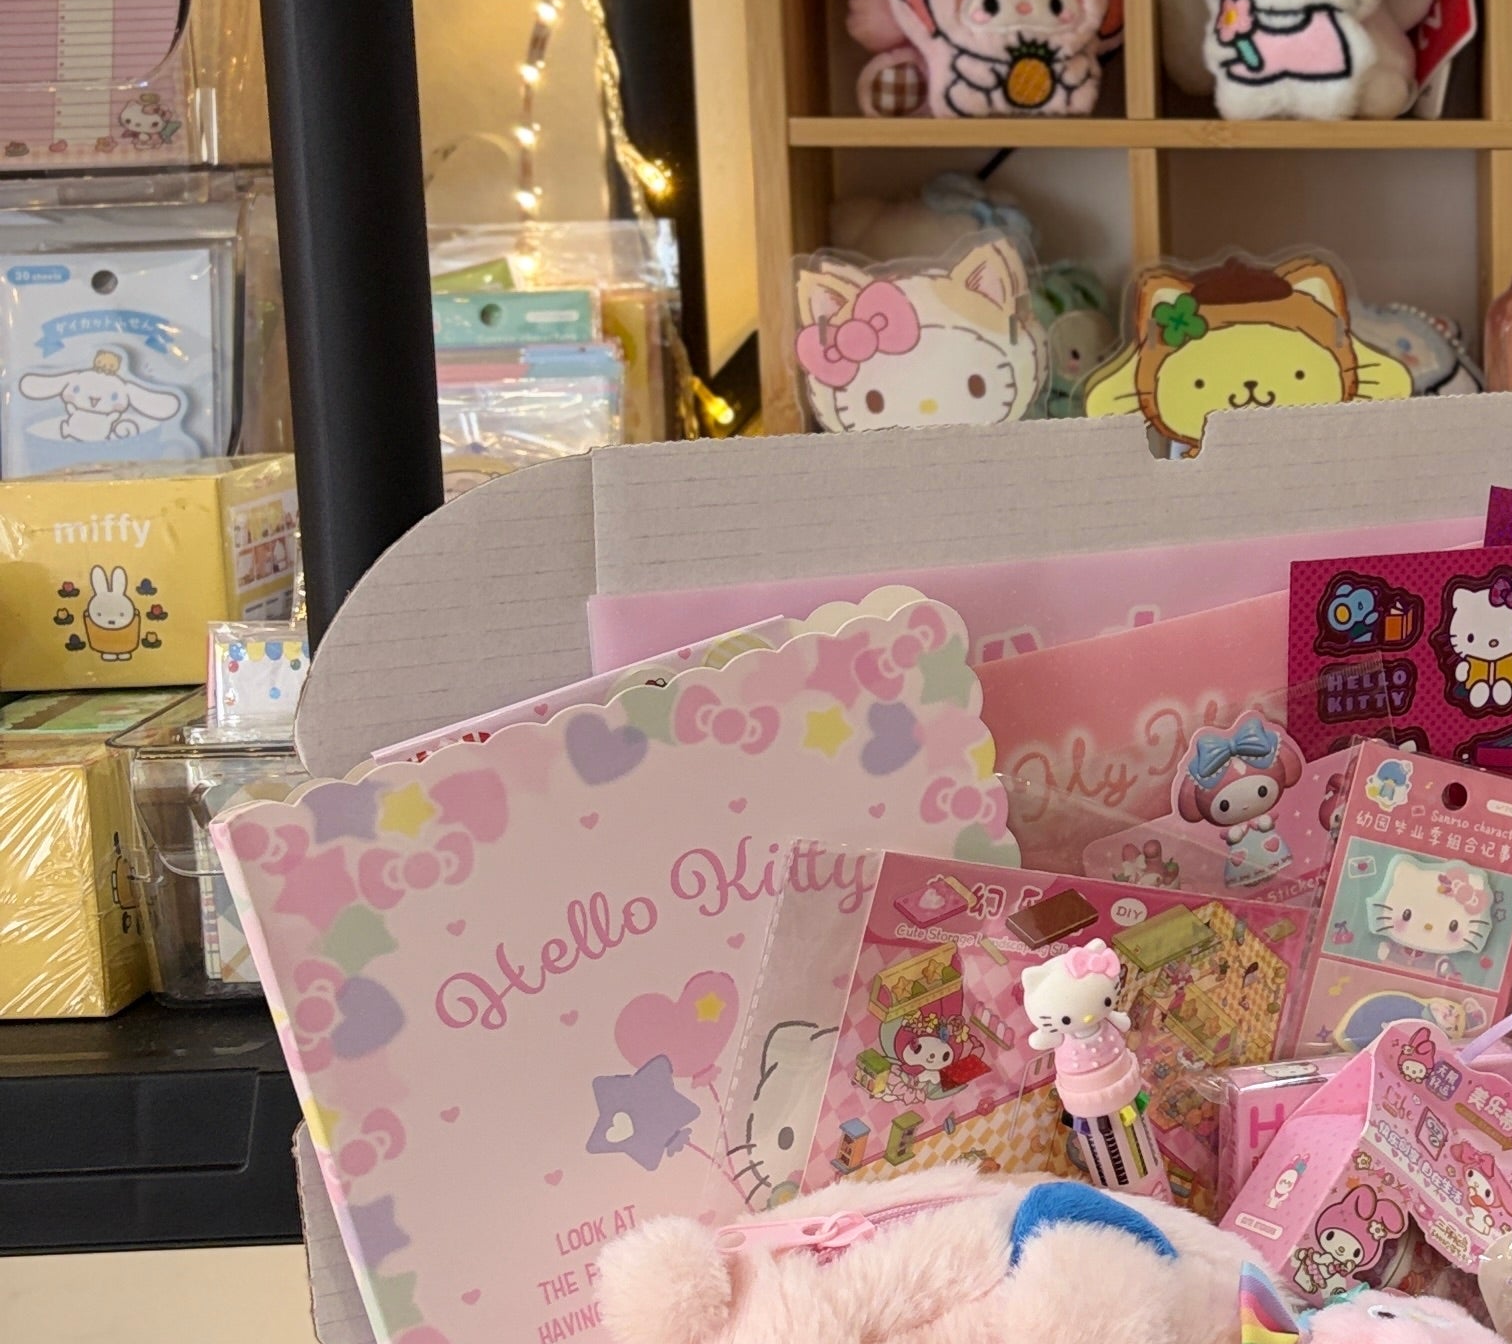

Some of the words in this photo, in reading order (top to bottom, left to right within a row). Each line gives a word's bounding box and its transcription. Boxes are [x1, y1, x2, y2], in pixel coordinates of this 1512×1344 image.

[54, 513, 151, 548] miffy
[1327, 668, 1407, 692] HELLO
[1327, 691, 1404, 713] KITTY
[1430, 810, 1470, 829] Sanrio
[1115, 904, 1143, 920] DIY
[435, 890, 658, 1031] Hello
[670, 835, 876, 916] Kitty
[895, 924, 925, 940] Cute
[555, 1215, 608, 1256] LOOK
[613, 1204, 636, 1236] AT
[536, 1270, 580, 1305] THE
